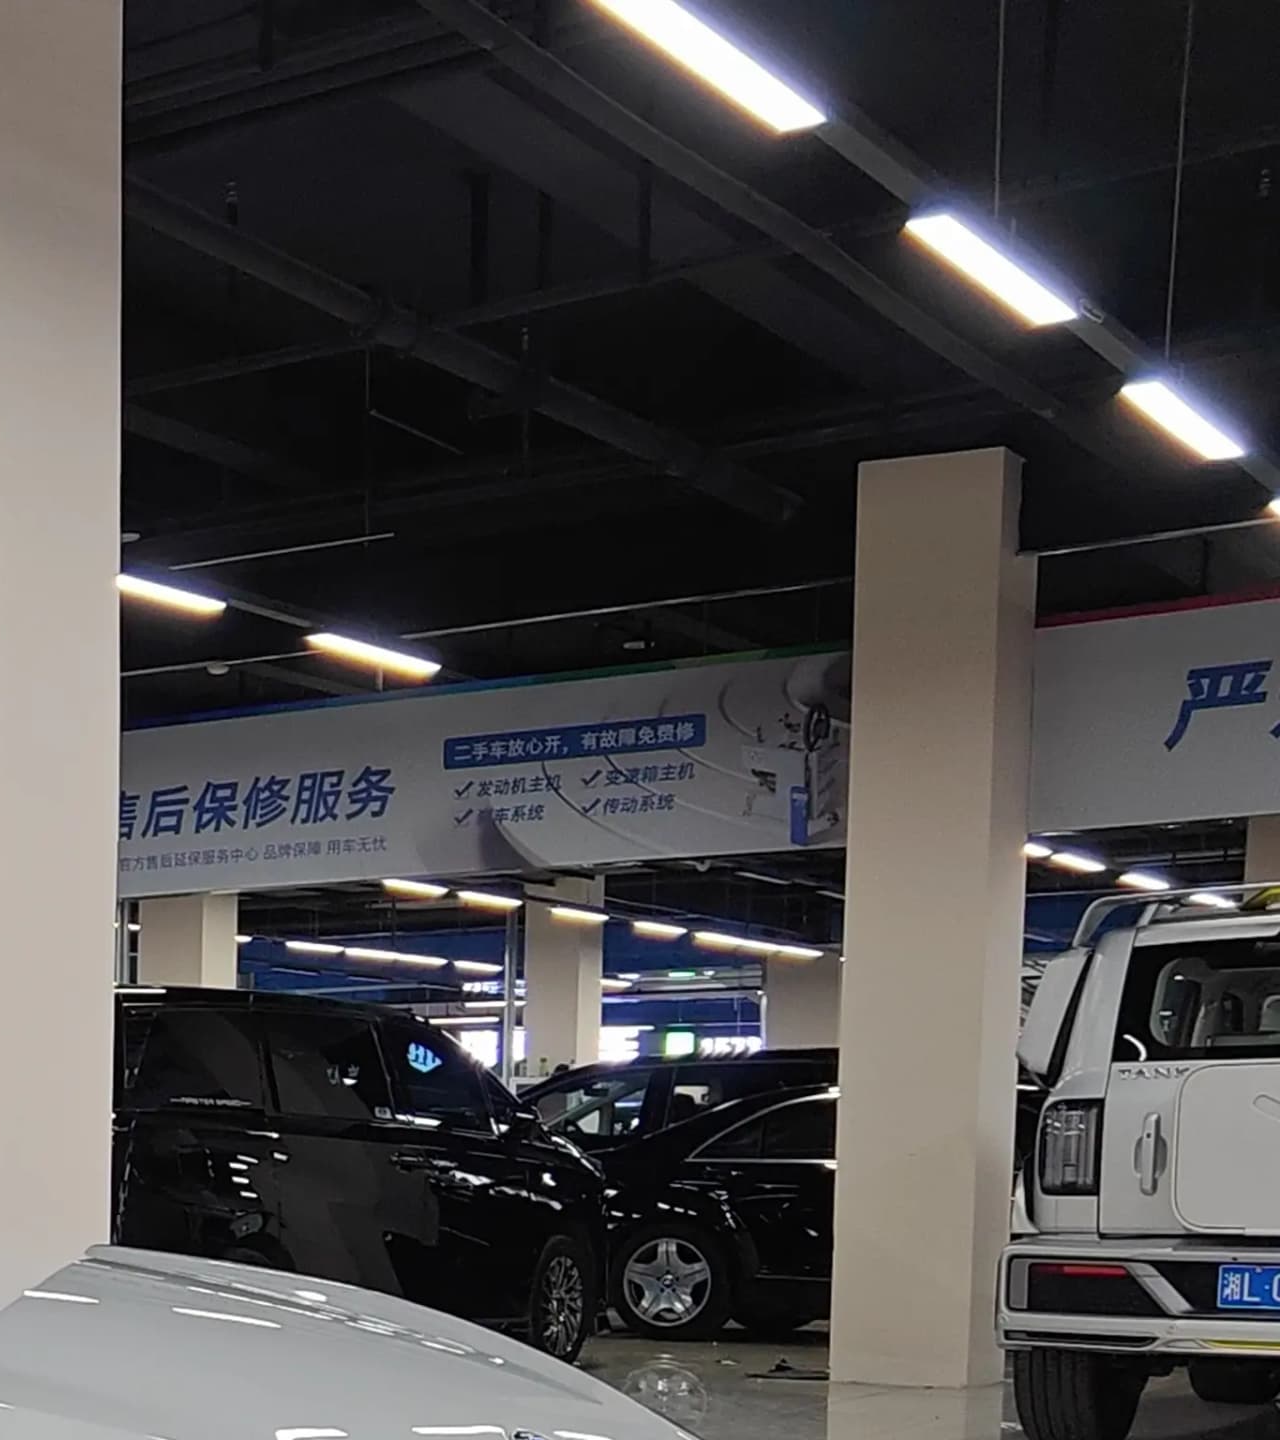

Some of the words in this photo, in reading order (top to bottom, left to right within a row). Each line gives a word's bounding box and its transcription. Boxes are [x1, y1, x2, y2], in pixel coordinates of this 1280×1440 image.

[453, 722, 695, 762] 二手车放心开，有故障免费修
[476, 773, 562, 797] 发动机主机
[478, 803, 545, 824] 车系统
[602, 792, 676, 817] 传动系统
[263, 840, 322, 860] 品牌保障
